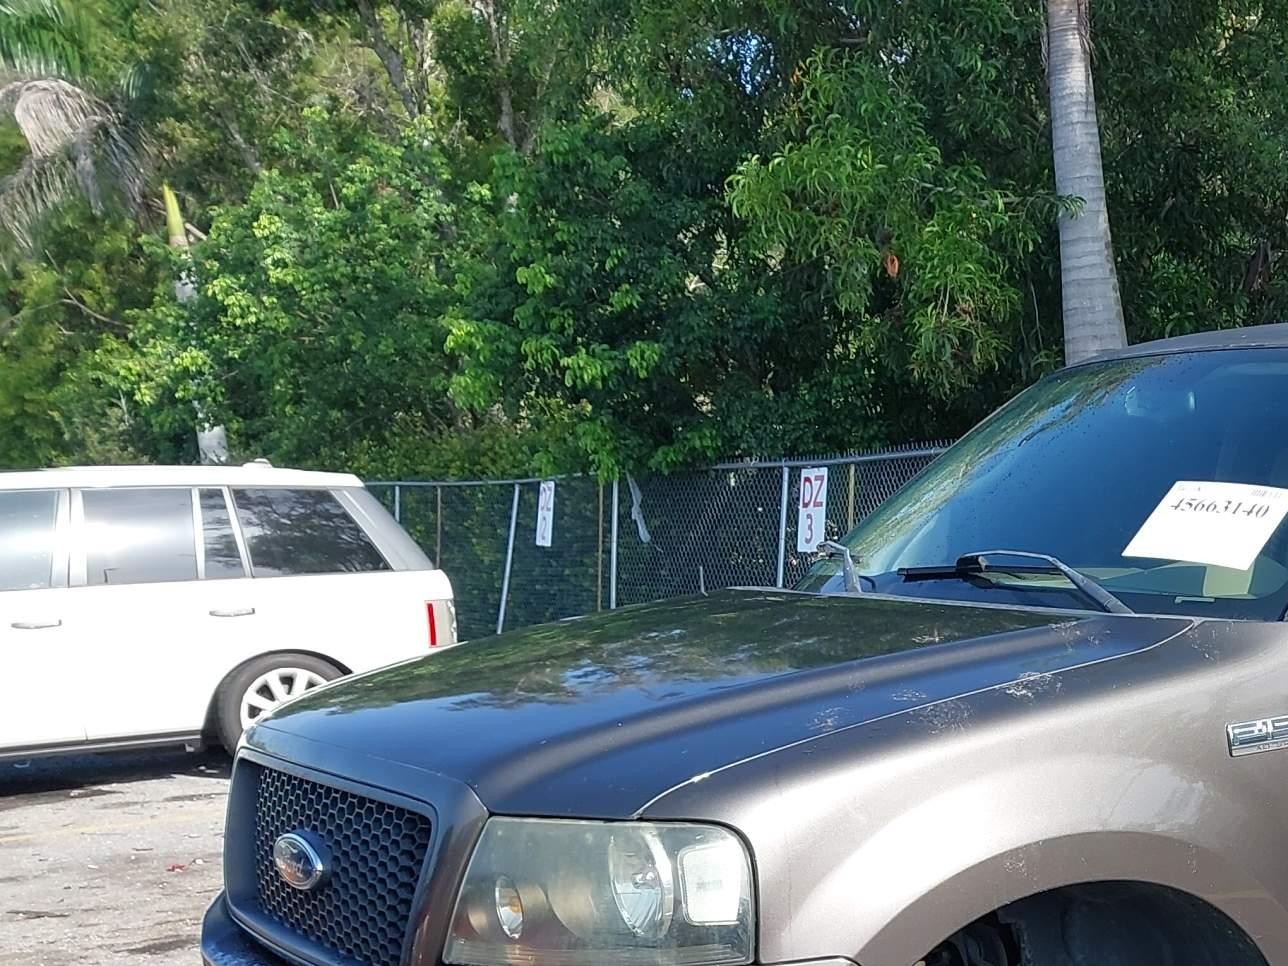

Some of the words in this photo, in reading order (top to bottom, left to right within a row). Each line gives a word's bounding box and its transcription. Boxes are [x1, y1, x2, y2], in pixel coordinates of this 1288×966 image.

[802, 475, 825, 509] DZ
[1170, 498, 1271, 518] 45663140
[804, 513, 813, 545] 3
